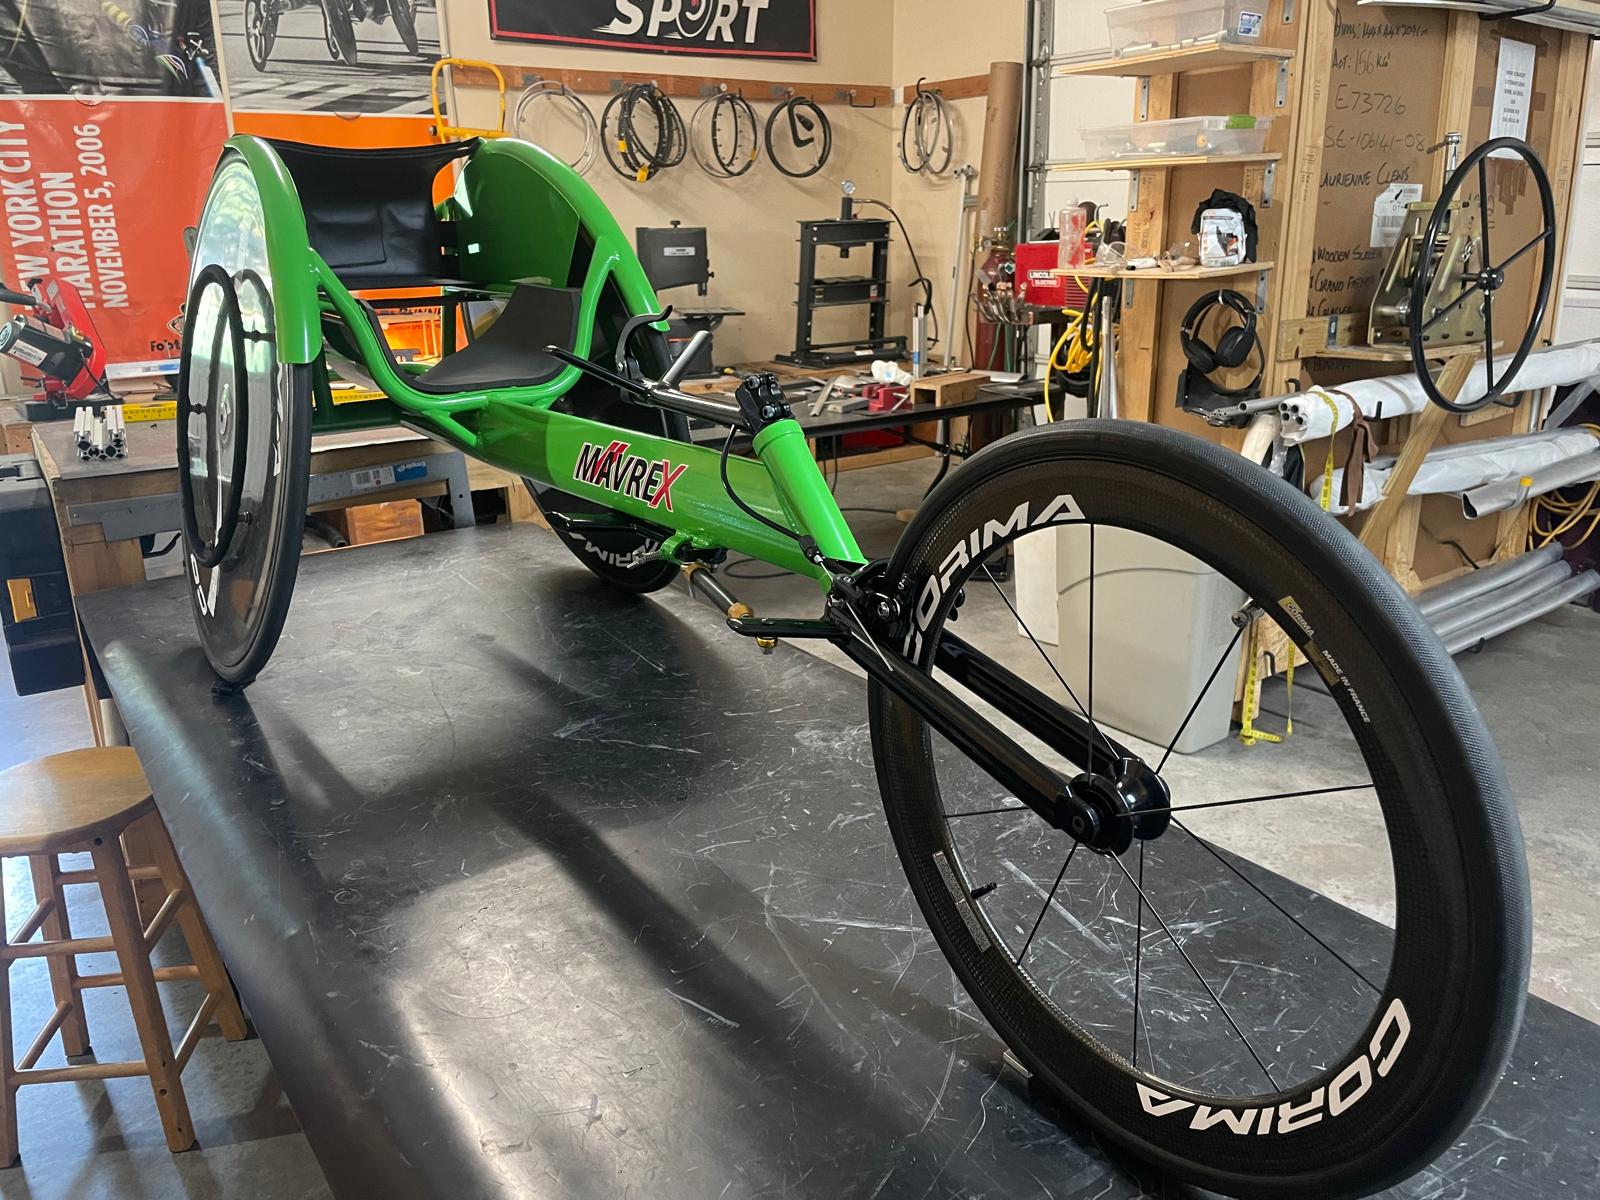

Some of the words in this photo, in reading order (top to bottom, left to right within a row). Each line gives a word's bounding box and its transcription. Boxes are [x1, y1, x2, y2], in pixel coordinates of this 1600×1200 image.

[0, 121, 32, 173] CITY
[73, 123, 108, 177] 2006
[1, 178, 45, 248] YORK
[83, 181, 116, 199] 5,
[87, 203, 130, 309] NOVEMBER
[1286, 601, 1315, 637] CORIMA
[1322, 650, 1343, 675] MADE
[1340, 676, 1351, 687] IN
[1347, 688, 1371, 723] FRANCE
[1136, 998, 1411, 1135] CORIMA
